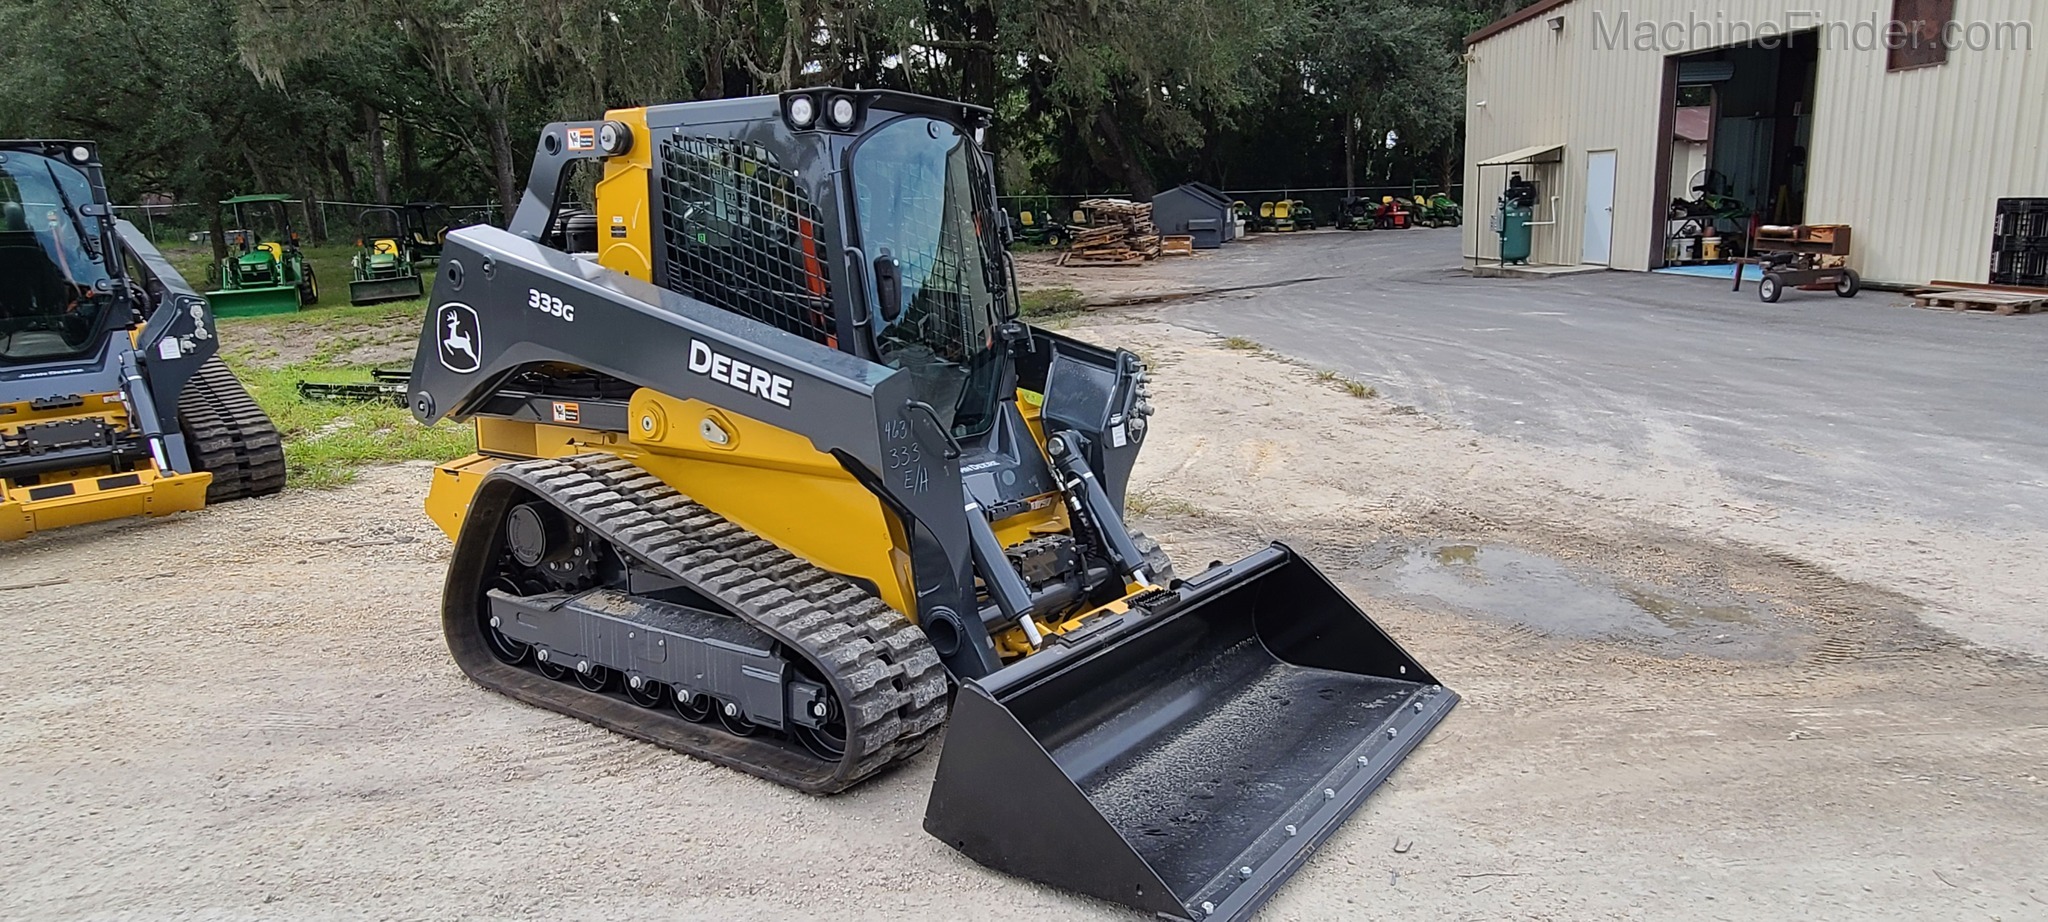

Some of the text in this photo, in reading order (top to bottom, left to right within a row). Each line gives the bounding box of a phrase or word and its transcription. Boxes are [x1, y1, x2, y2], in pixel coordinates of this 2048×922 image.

[527, 288, 575, 322] 333G
[688, 338, 793, 407] DEERE
[884, 419, 914, 442] 4631
[889, 442, 921, 469] 333
